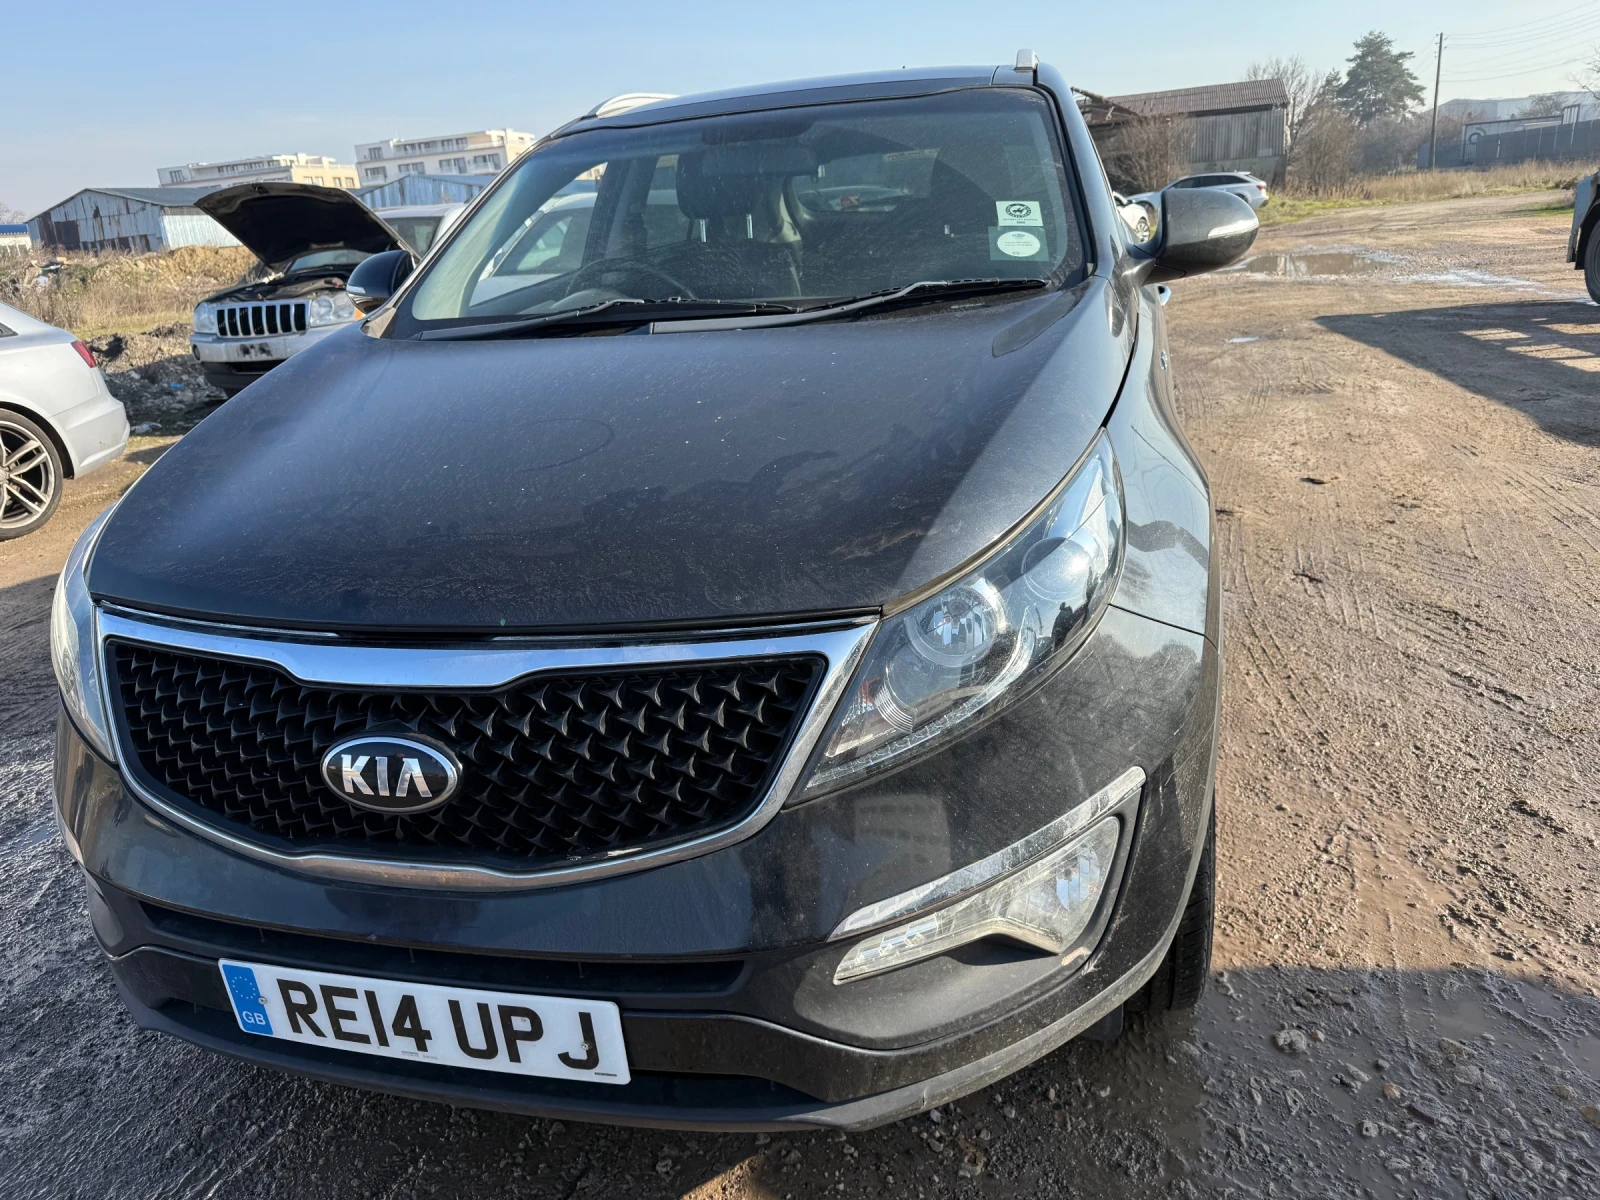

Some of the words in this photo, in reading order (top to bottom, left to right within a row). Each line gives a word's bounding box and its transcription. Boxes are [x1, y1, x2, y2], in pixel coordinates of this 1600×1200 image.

[340, 753, 433, 798] KIA
[242, 1009, 267, 1026] GB
[276, 978, 433, 1052] RE14
